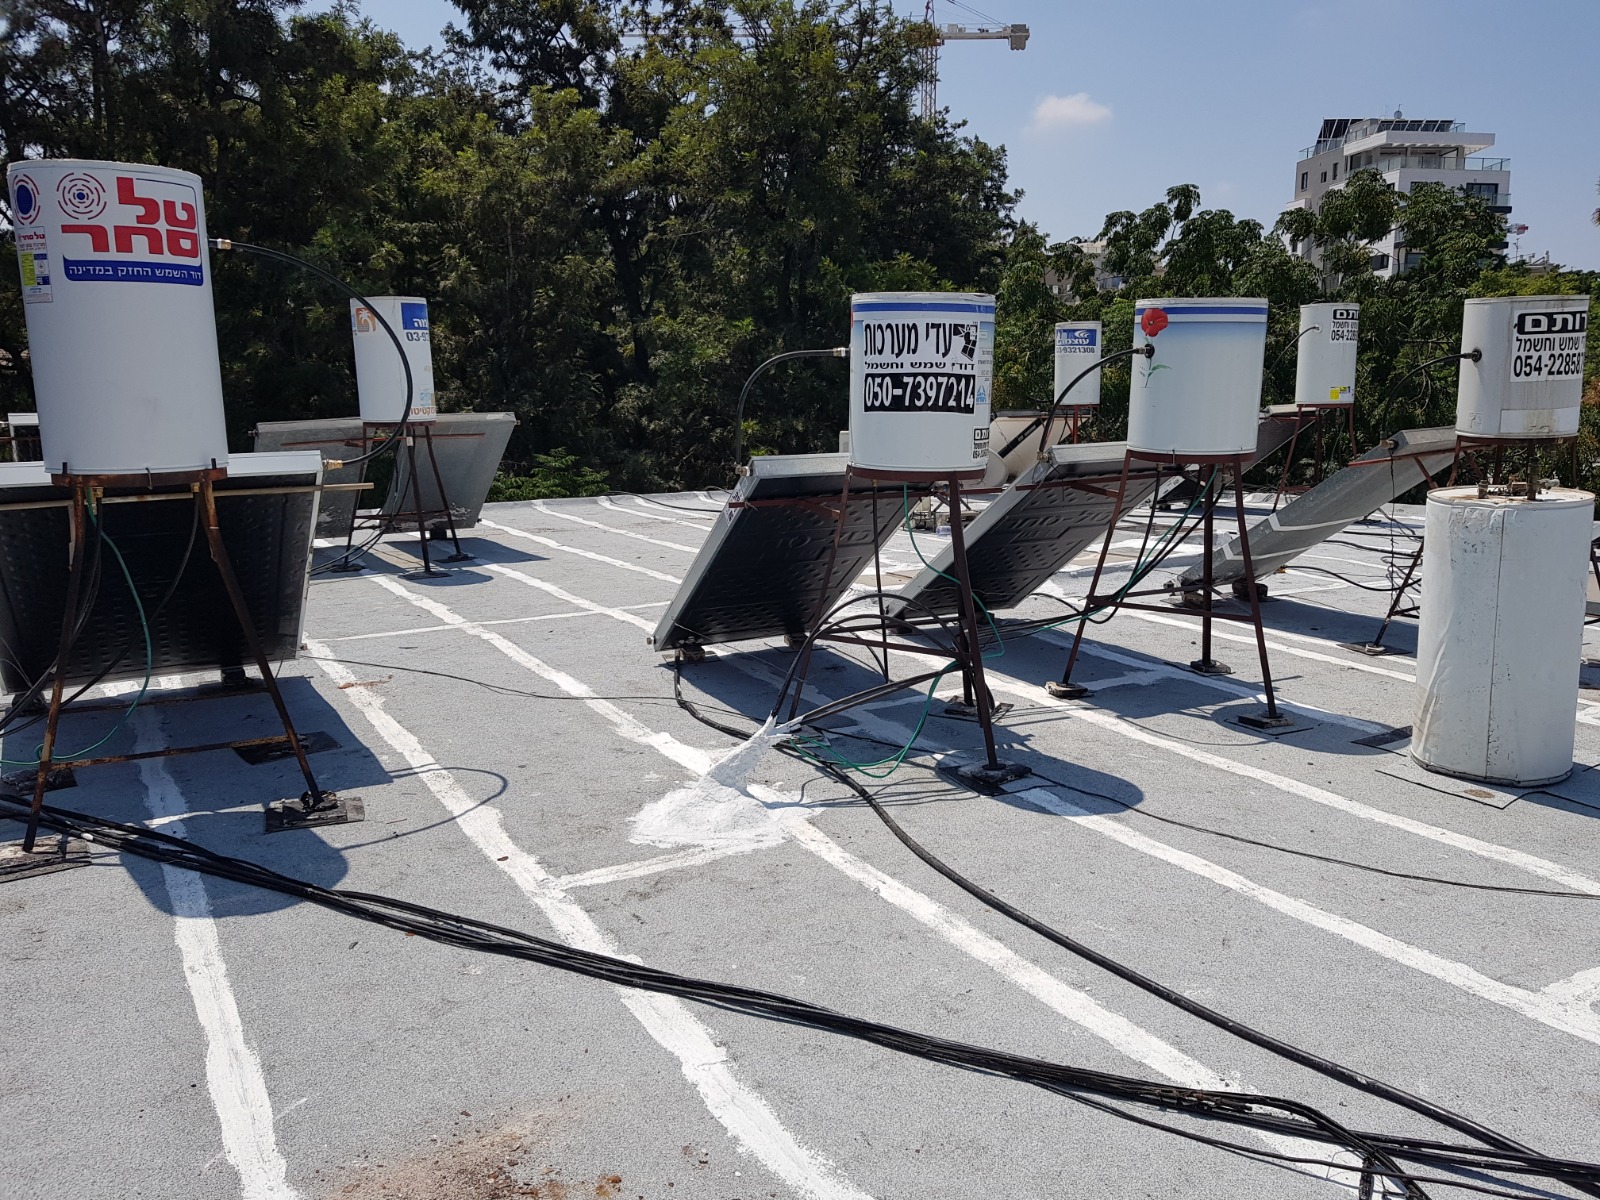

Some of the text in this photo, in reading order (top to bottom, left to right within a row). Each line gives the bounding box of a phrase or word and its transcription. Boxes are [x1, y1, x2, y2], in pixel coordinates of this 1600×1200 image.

[116, 176, 197, 230] טל
[61, 224, 200, 259] סחר
[69, 266, 113, 275] במדינה
[117, 266, 152, 277] החזק
[155, 268, 188, 279] השמש
[864, 322, 953, 359] עדי מערכות
[1515, 335, 1556, 353] וחשמל
[864, 361, 904, 370] וחשמל
[910, 361, 946, 370] שמש
[1513, 351, 1584, 378] 054-22858
[865, 375, 974, 409] 050-7397214
